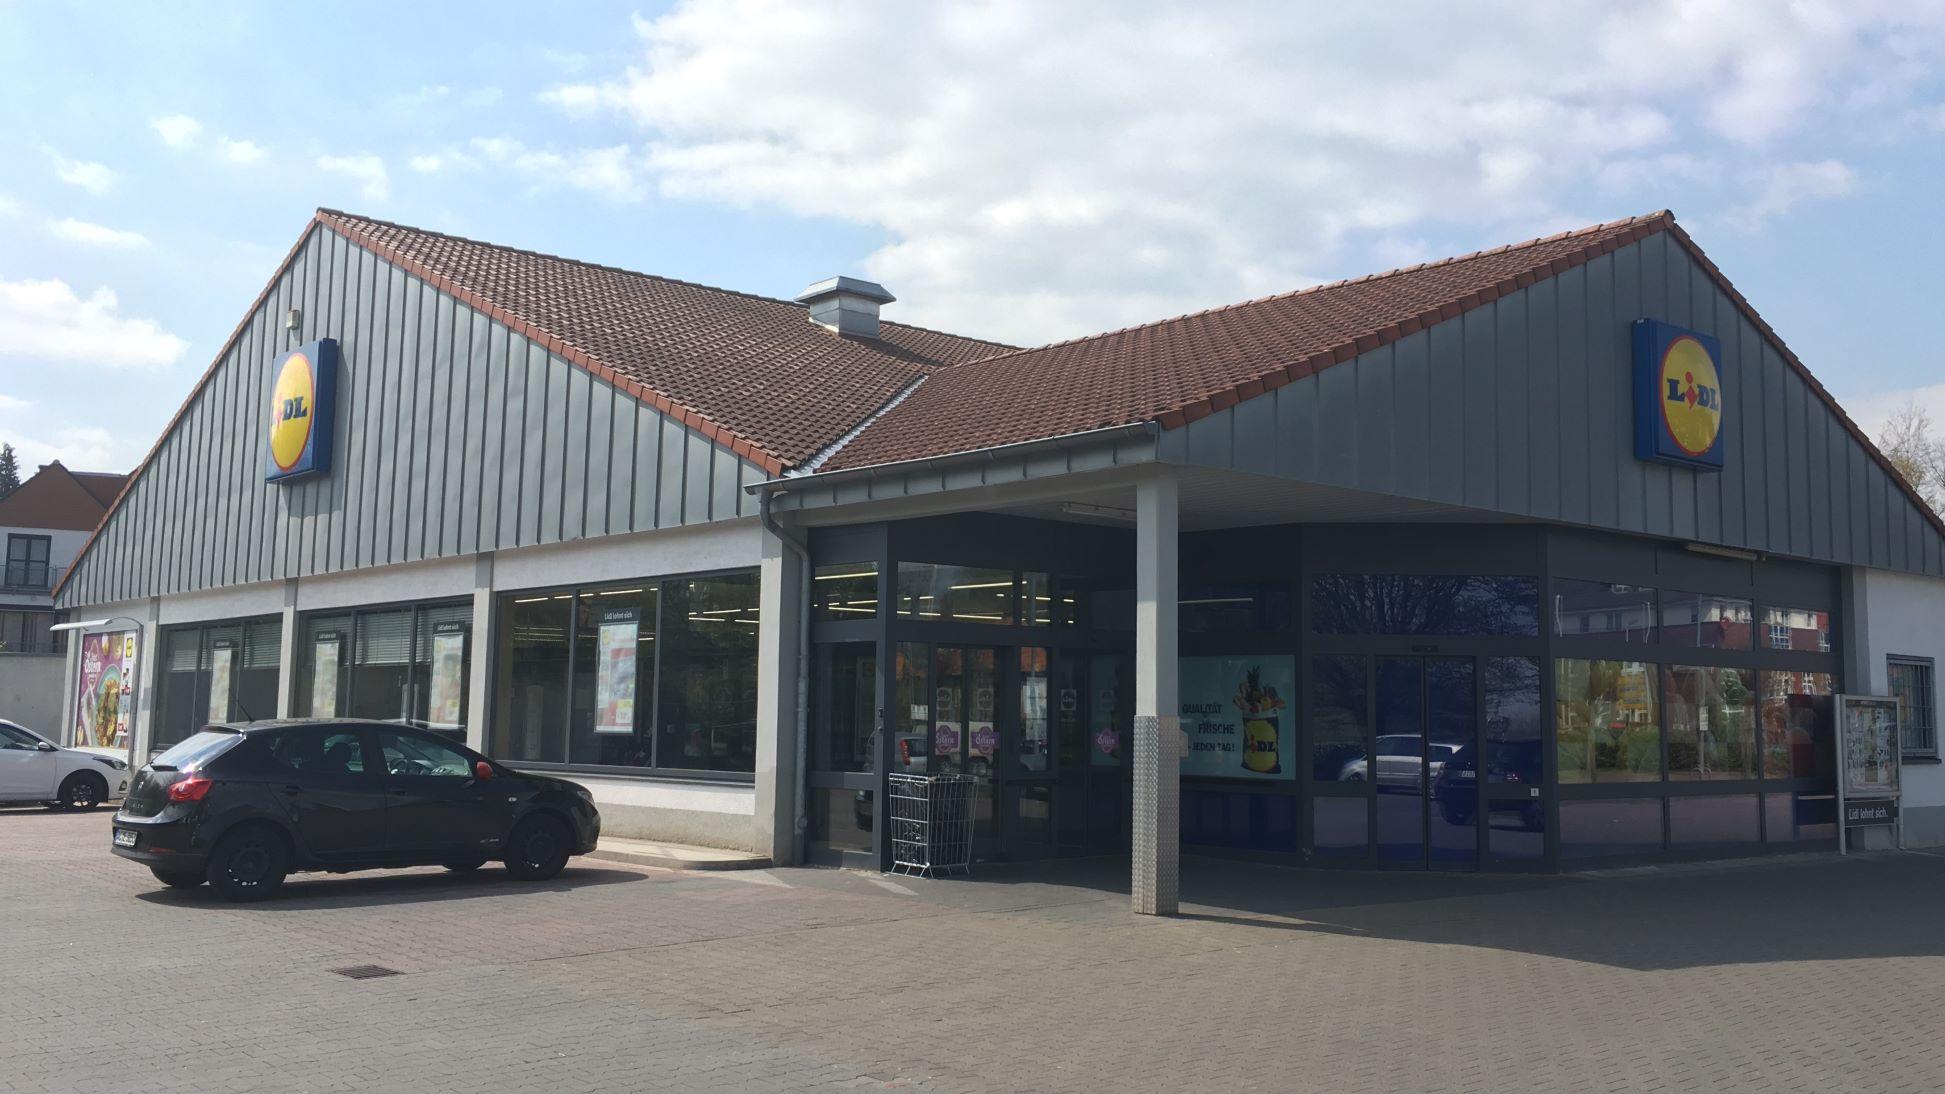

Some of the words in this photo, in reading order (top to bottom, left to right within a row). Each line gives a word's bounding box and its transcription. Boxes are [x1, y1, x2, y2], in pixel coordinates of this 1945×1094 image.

[1198, 723, 1235, 734] FRISCHE
[1848, 808, 1859, 820] Lidl
[1860, 807, 1874, 819] lohnt
